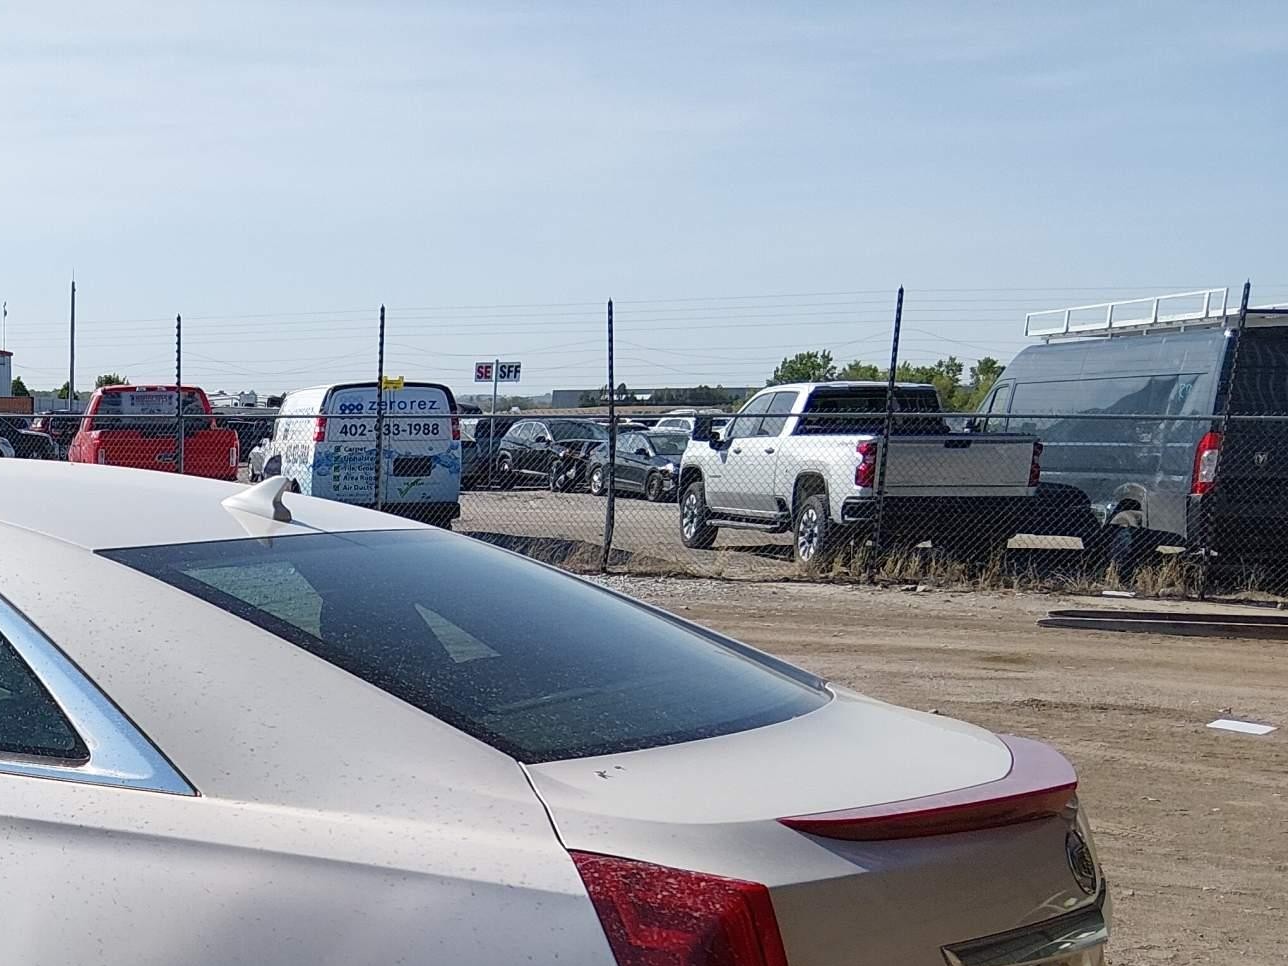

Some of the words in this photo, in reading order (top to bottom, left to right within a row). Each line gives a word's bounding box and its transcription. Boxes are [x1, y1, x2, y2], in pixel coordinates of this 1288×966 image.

[476, 365, 492, 380] SE
[499, 364, 521, 380] SFF
[367, 399, 441, 411] zerorez
